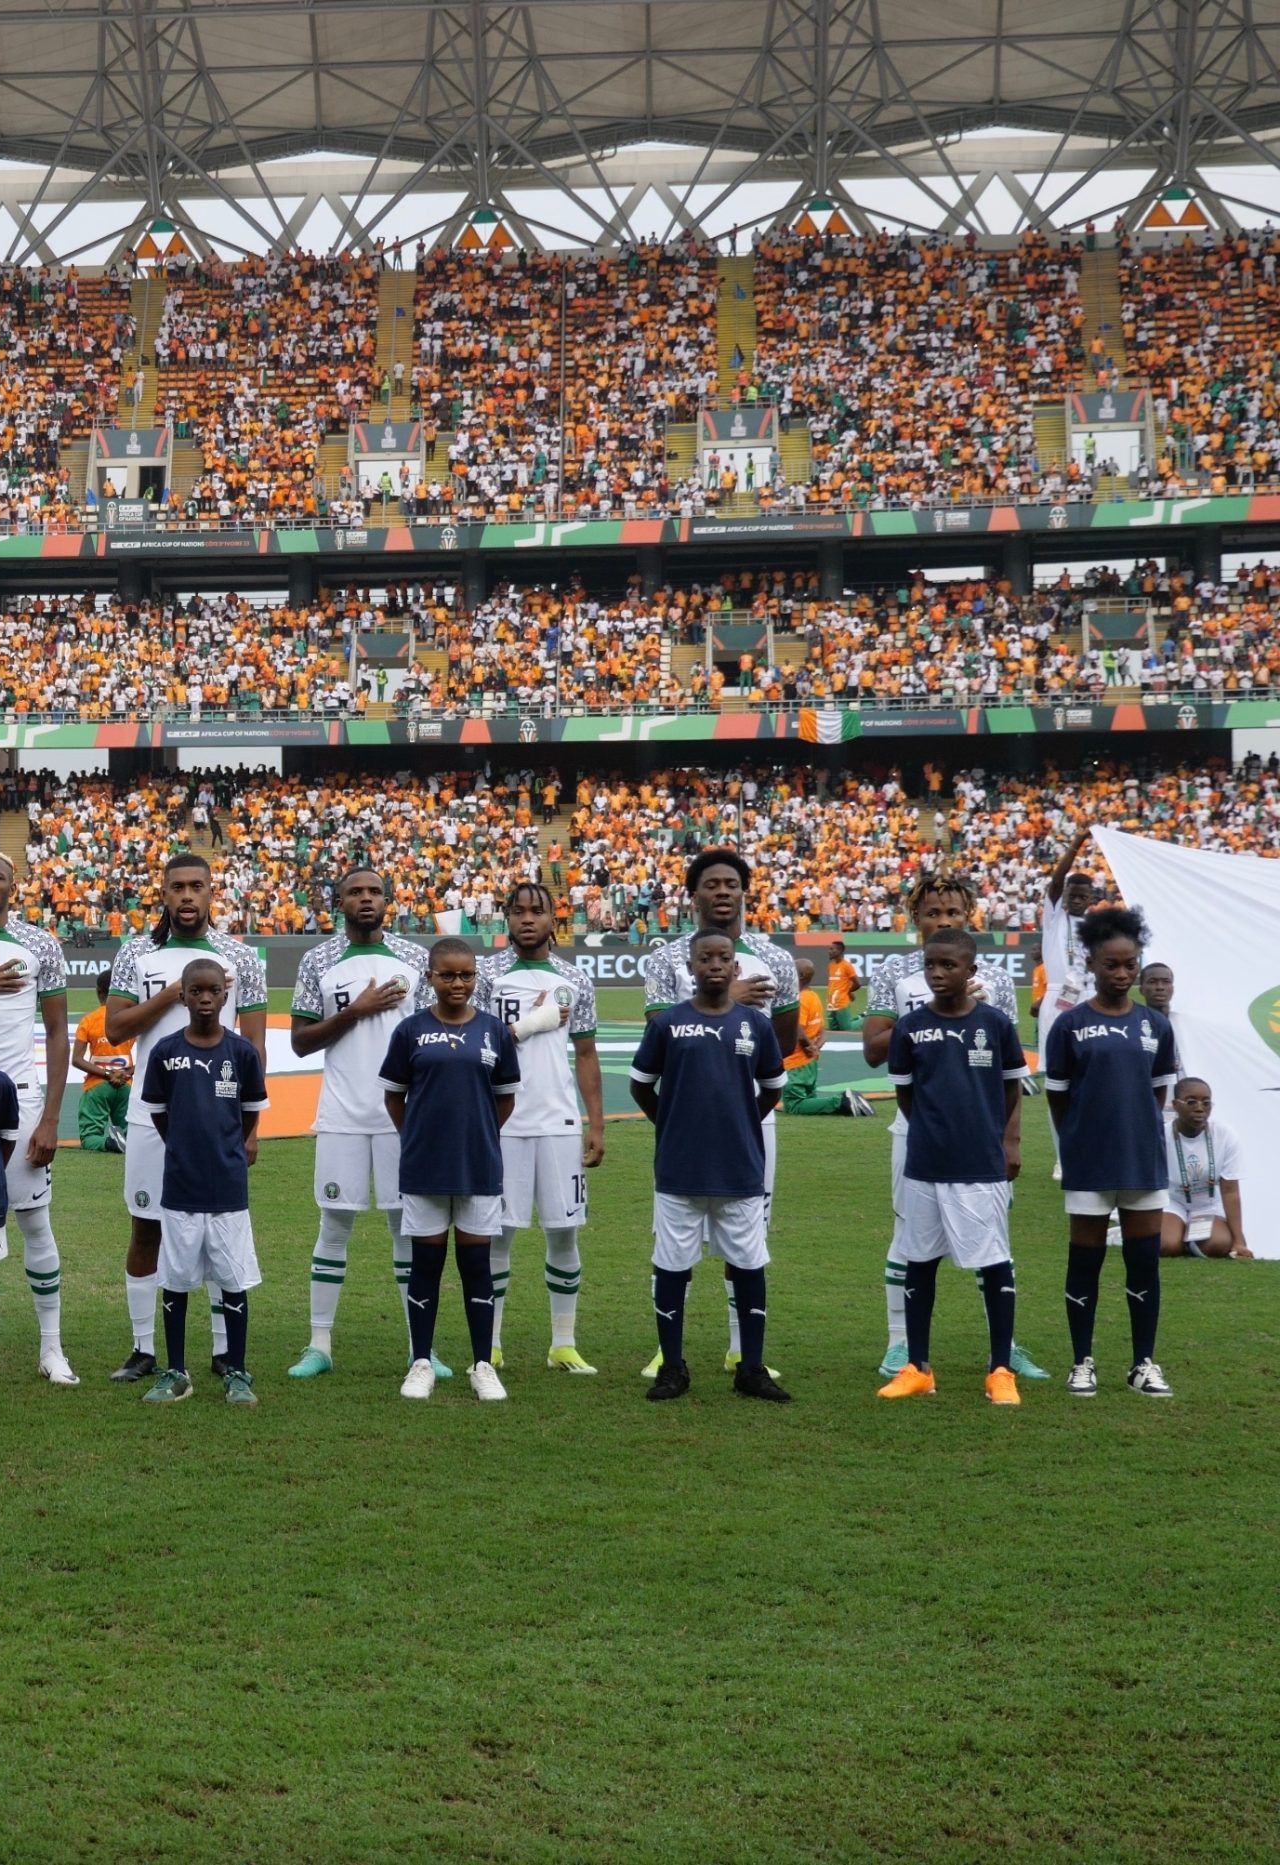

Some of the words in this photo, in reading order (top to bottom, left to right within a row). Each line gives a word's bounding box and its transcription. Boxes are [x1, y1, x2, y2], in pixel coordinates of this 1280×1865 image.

[494, 998, 520, 1025] 18
[669, 1024, 705, 1038] VISA
[908, 1028, 944, 1044] VISA
[1072, 1025, 1108, 1042] VISA
[416, 1033, 449, 1046] VISA
[163, 1056, 191, 1071] VISA
